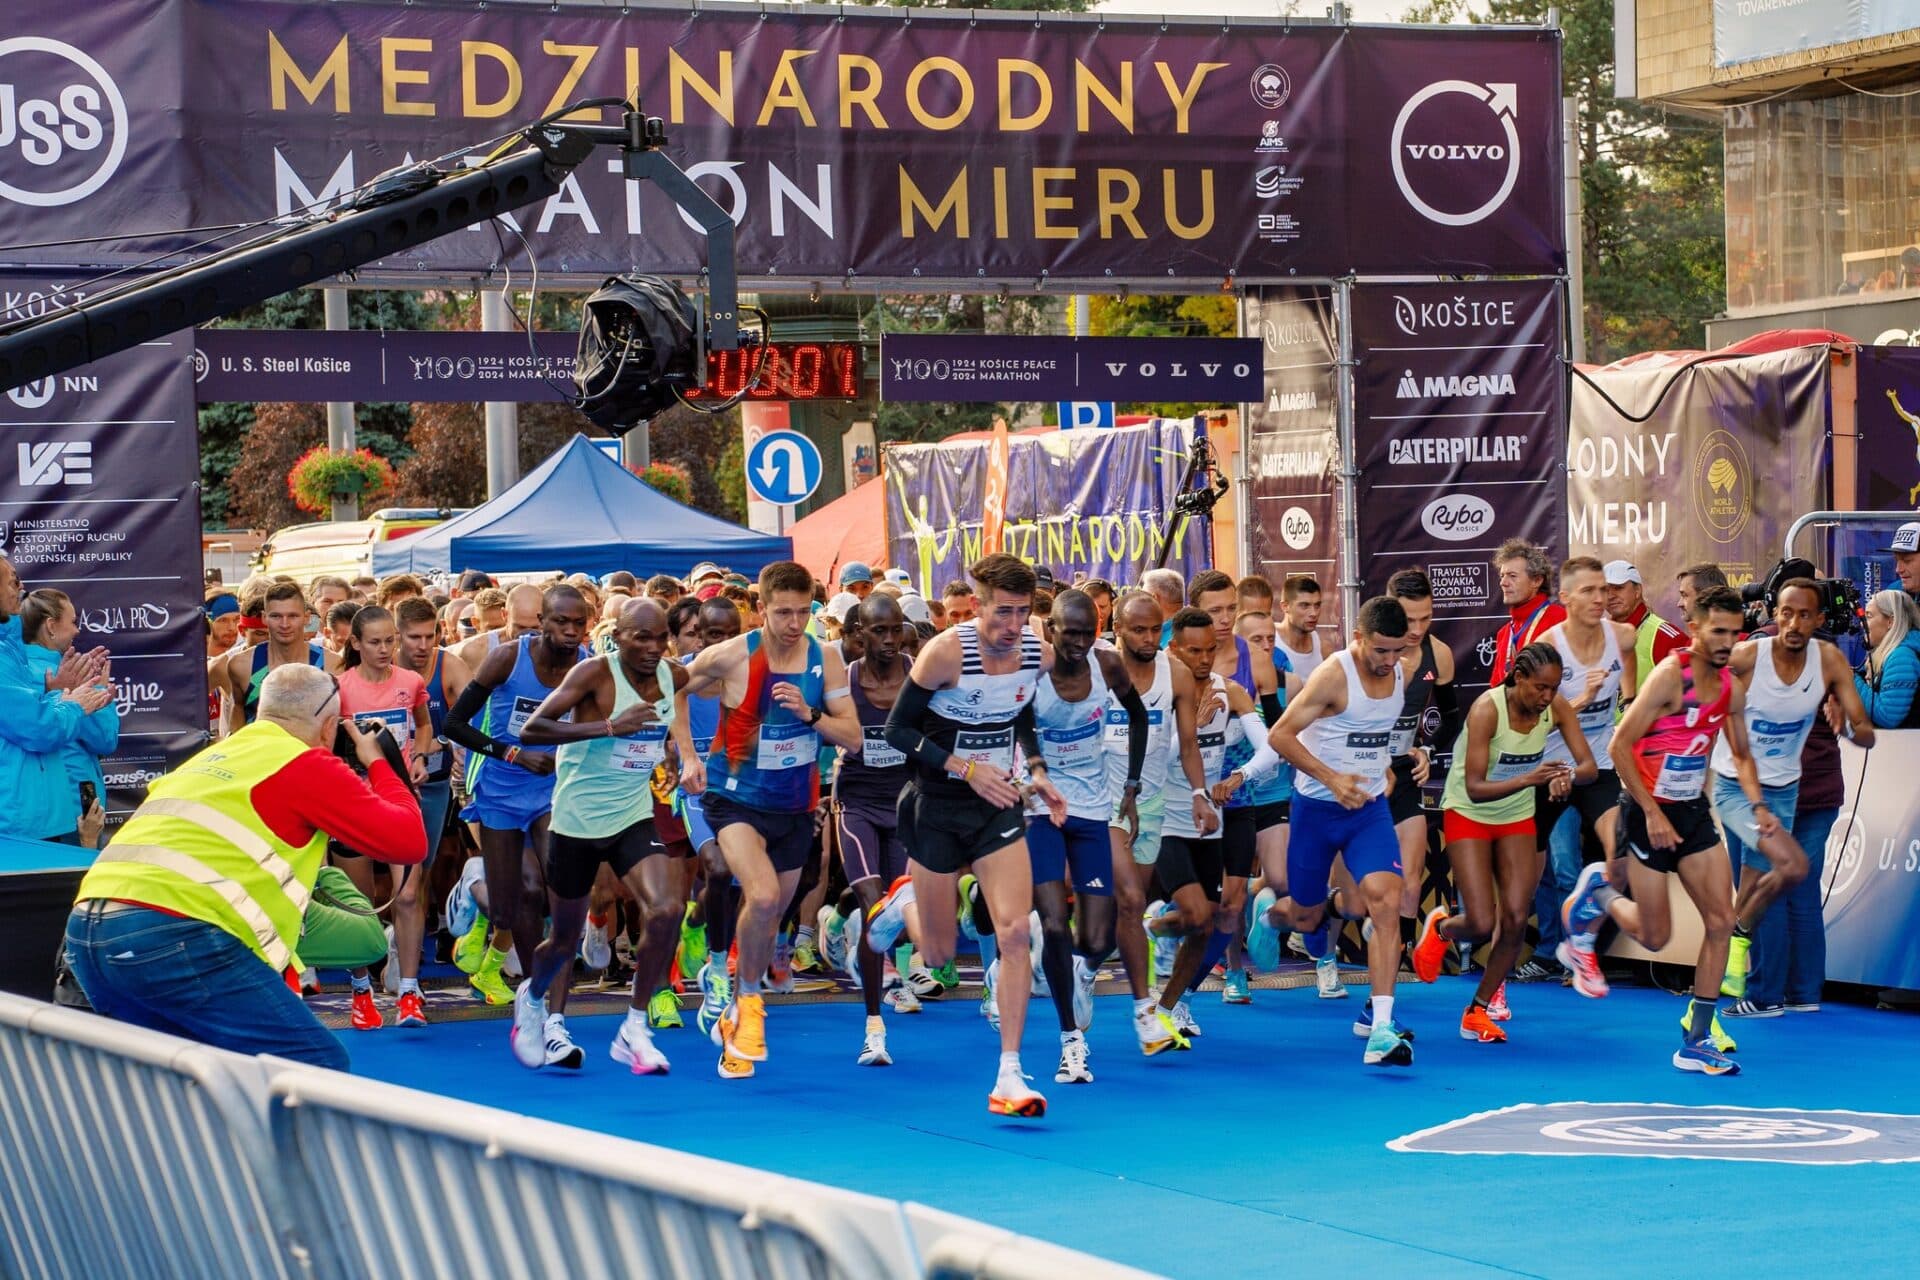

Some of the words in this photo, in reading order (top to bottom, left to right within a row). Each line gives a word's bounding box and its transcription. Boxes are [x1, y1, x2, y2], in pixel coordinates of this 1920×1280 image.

[1260, 138, 1284, 147] AIMS
[1406, 145, 1505, 161] VOLVO
[900, 164, 1216, 240] MIERU
[1421, 296, 1515, 327] KOŠICE
[222, 357, 238, 372] U.
[243, 357, 258, 372] S.
[263, 357, 299, 372] Steel
[304, 357, 351, 372] Košice
[478, 357, 504, 366] 1924
[557, 358, 577, 367] PEA
[952, 359, 976, 368] 1924
[980, 358, 1019, 369] KOŠICE
[1023, 360, 1057, 369] PEACE
[478, 371, 504, 379] 2024
[509, 370, 575, 379] MARAHON
[1105, 362, 1250, 377] VOLVO
[952, 372, 976, 381] 2024
[980, 372, 1040, 381] MARATHON
[64, 376, 98, 392] NN
[1424, 374, 1516, 398] MAGNA
[1281, 391, 1317, 410] MAGNA
[1389, 435, 1521, 465] CATERPILLAR
[1262, 451, 1320, 477] CATERPILLAR
[1431, 503, 1484, 531] Ryba
[1568, 501, 1667, 545] MIERU
[14, 518, 90, 529] MINISTERSTVO
[1285, 516, 1310, 540] Ryba
[14, 531, 84, 544] CESTOVNÉHO
[88, 532, 126, 542] RUCHU
[14, 544, 21, 553] A
[24, 543, 67, 554] ŠPORTU
[14, 553, 76, 564] SLOVENSKEJ
[80, 551, 133, 562] REPUBLIKY
[1432, 567, 1465, 577] TRAVEL
[1467, 566, 1480, 576] TO
[1432, 576, 1475, 587] SLOVAKIA
[1432, 586, 1461, 597] GOOD
[1463, 585, 1483, 596] IDEA
[79, 606, 126, 634] AQUA
[131, 603, 169, 631] PRO
[628, 743, 647, 753] PACE
[774, 742, 795, 752] PACE
[1057, 743, 1080, 753] PACE
[871, 753, 907, 765] CATERPILL
[969, 752, 991, 762] PACE
[1879, 838, 1897, 871] U.
